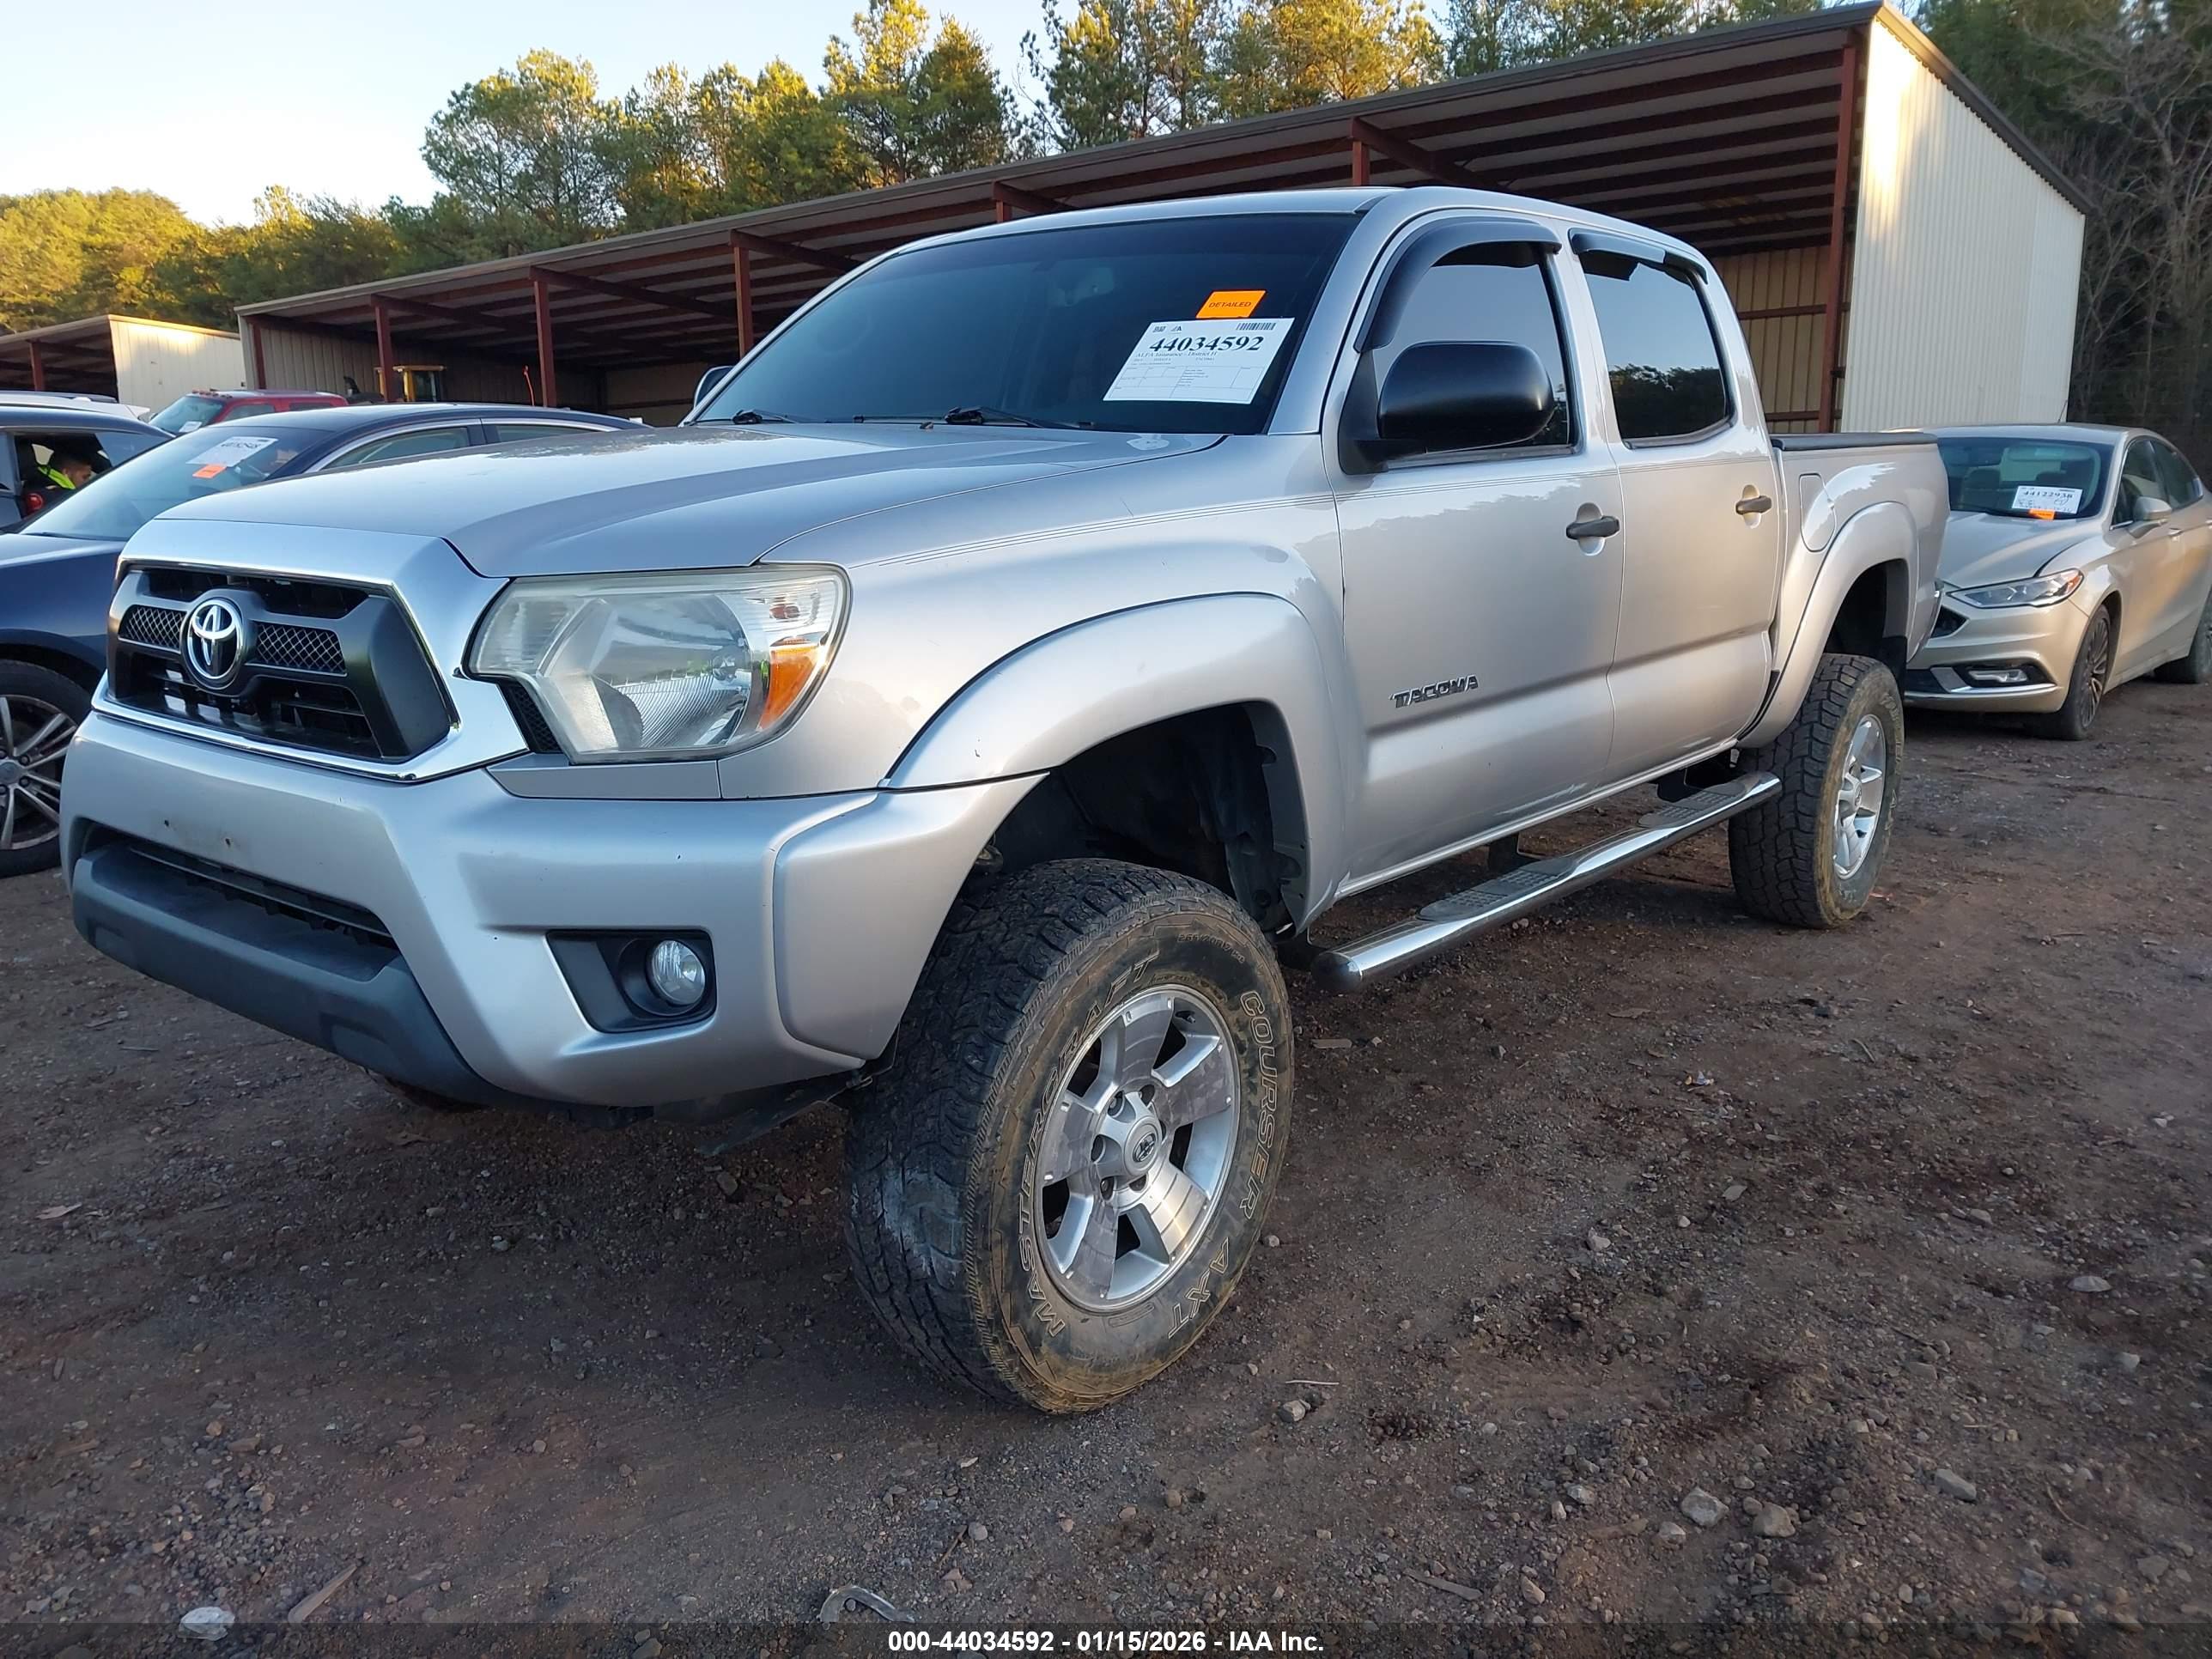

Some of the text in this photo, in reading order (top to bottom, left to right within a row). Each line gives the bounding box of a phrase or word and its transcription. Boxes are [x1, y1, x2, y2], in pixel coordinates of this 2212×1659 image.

[1150, 337, 1264, 351] 44034592
[1389, 674, 1479, 708] TACOMA
[1018, 949, 1160, 1337] MASTERCRAFT
[1168, 991, 1278, 1340] COURSER AXT
